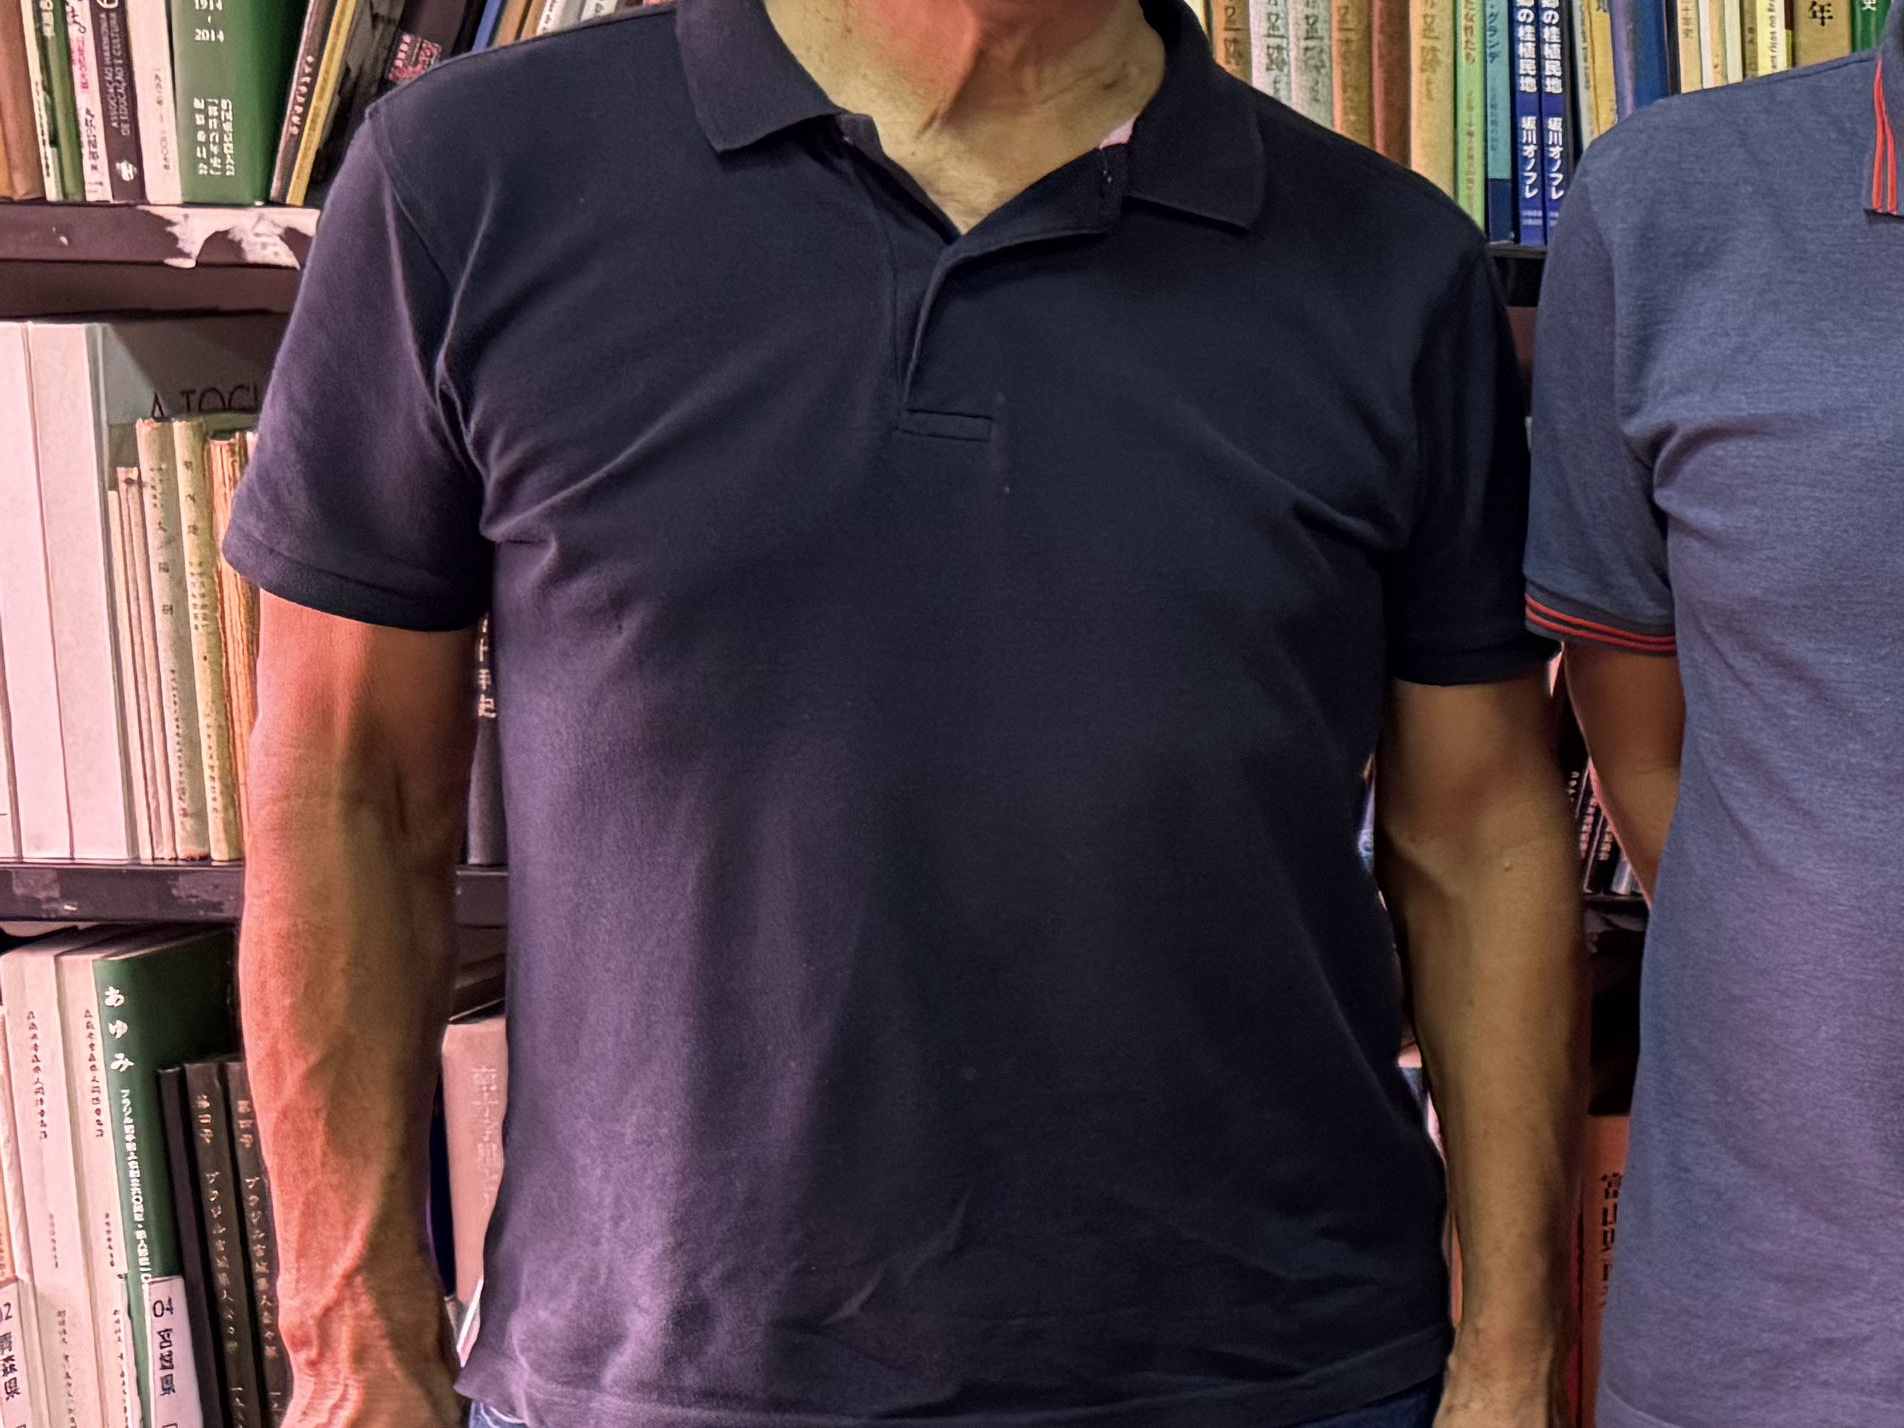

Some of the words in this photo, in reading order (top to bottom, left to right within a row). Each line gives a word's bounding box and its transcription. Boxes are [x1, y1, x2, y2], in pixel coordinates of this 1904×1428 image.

[194, 28, 225, 43] 2014
[104, 985, 135, 1073] あゆみ
